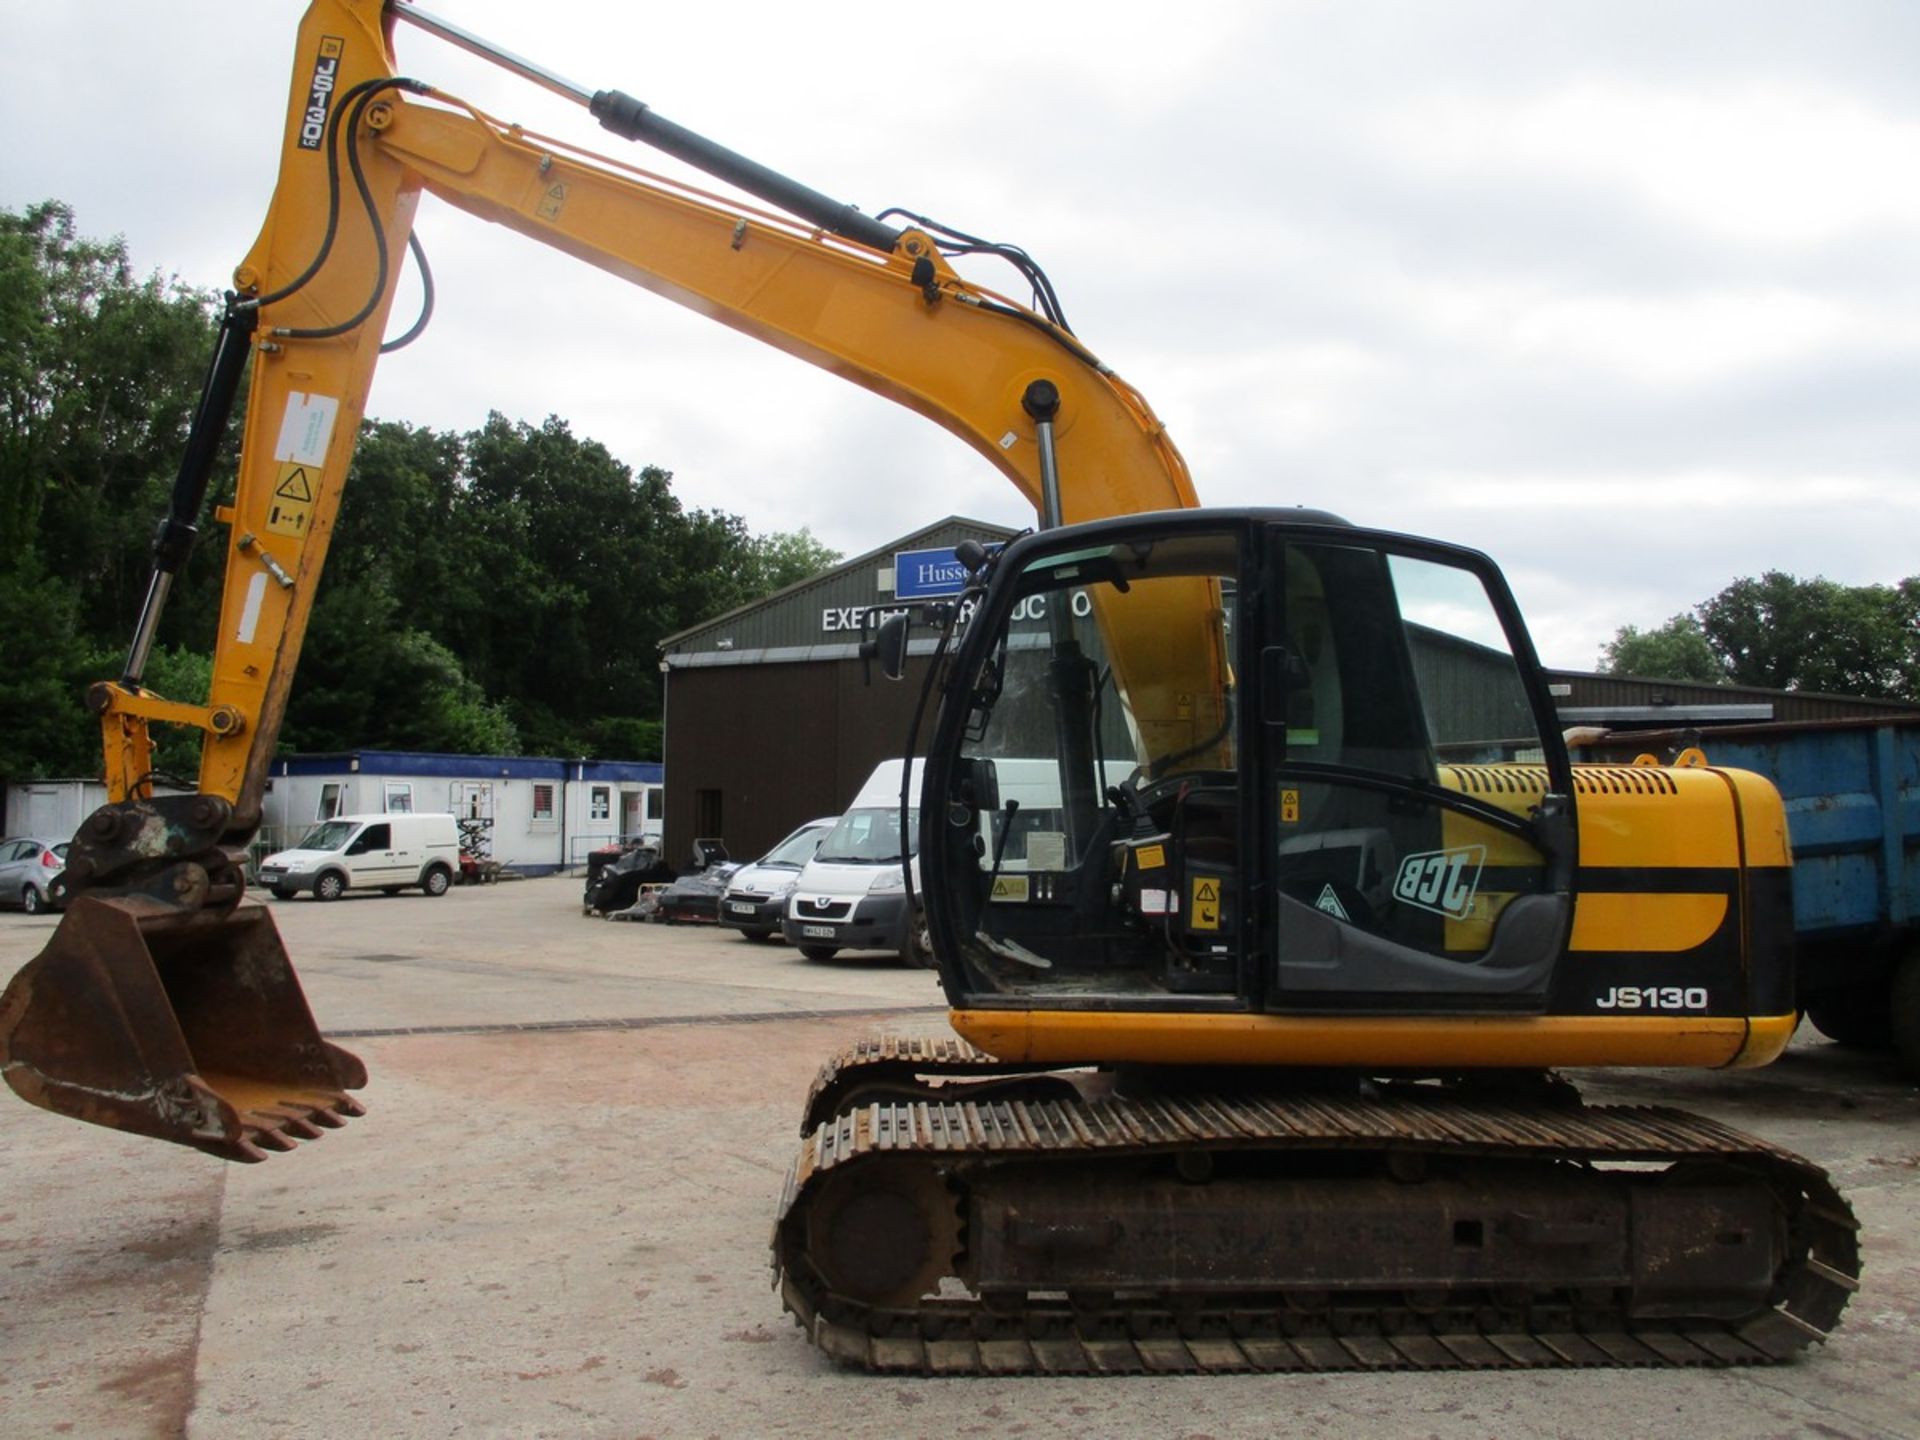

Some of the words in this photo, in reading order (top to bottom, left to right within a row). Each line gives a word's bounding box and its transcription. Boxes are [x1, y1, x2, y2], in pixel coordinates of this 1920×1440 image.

[918, 563, 989, 584] Husse
[822, 604, 910, 632] EXET
[1596, 986, 1708, 1009] JS130
